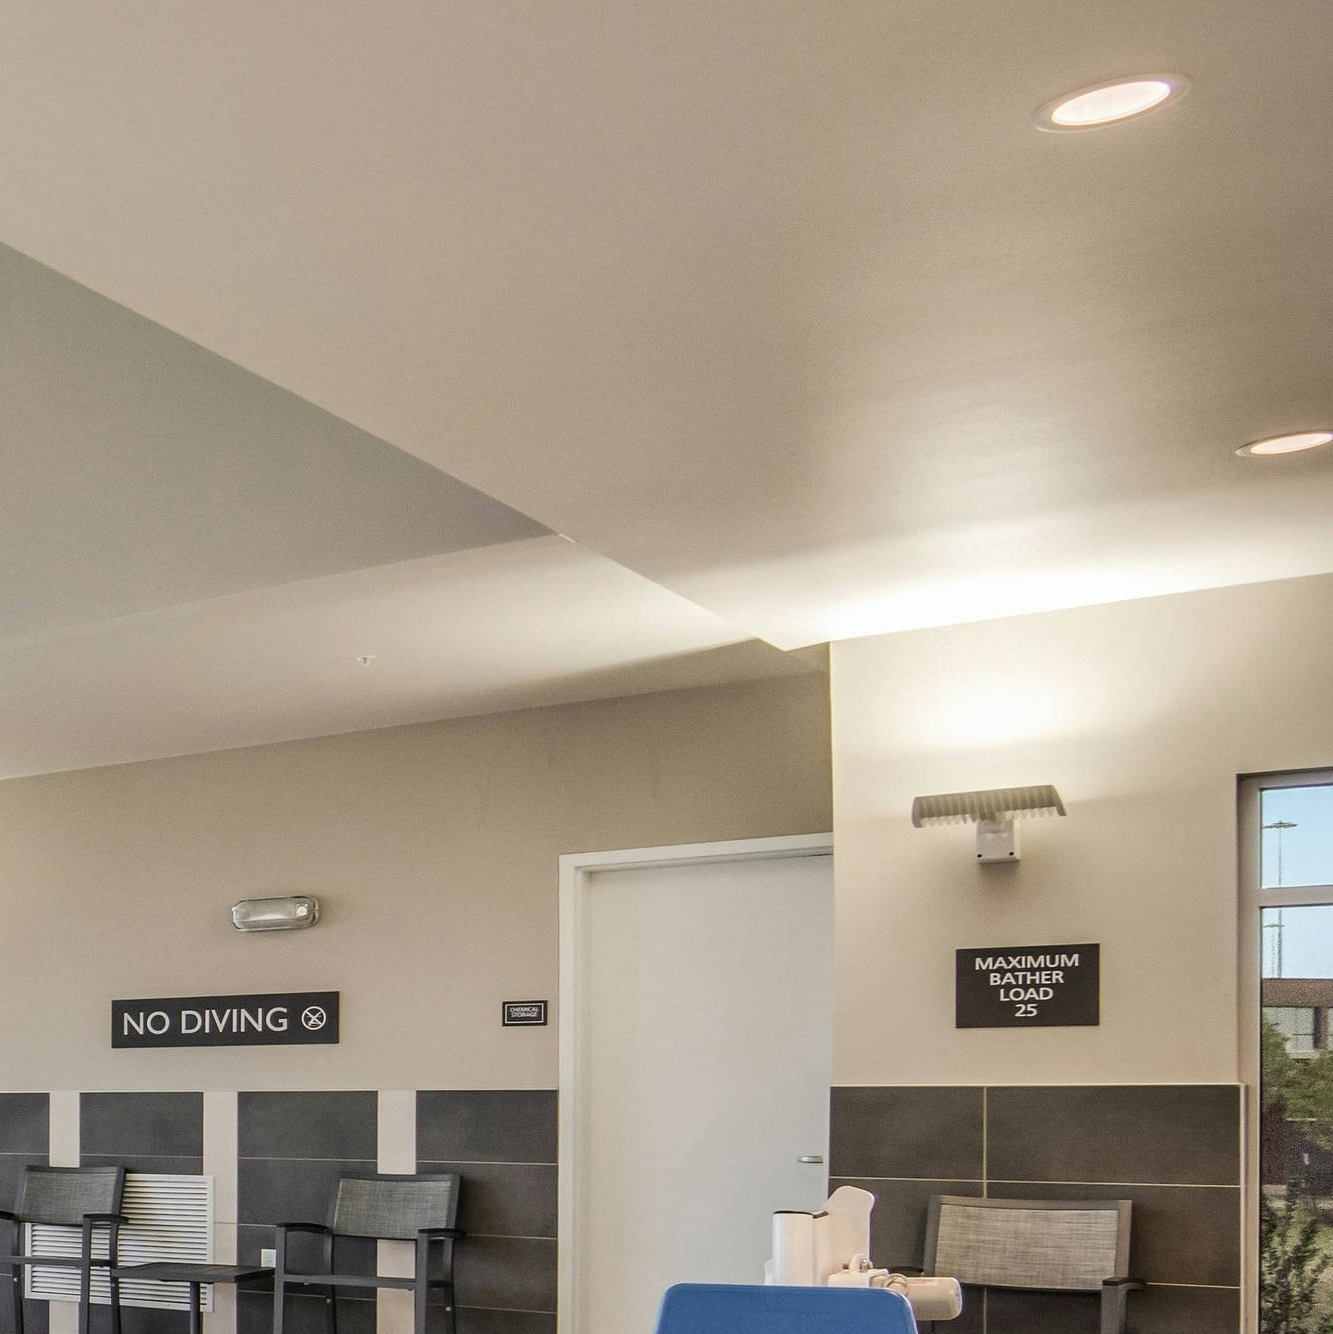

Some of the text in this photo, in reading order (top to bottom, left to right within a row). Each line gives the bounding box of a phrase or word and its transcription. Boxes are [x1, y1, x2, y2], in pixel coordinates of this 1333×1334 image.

[975, 954, 1079, 970] MAXIMUM
[990, 971, 1064, 985] BATHER
[1000, 987, 1054, 1001] LOAD
[1014, 1004, 1038, 1017] 25
[123, 1007, 288, 1036] NO DIVING
